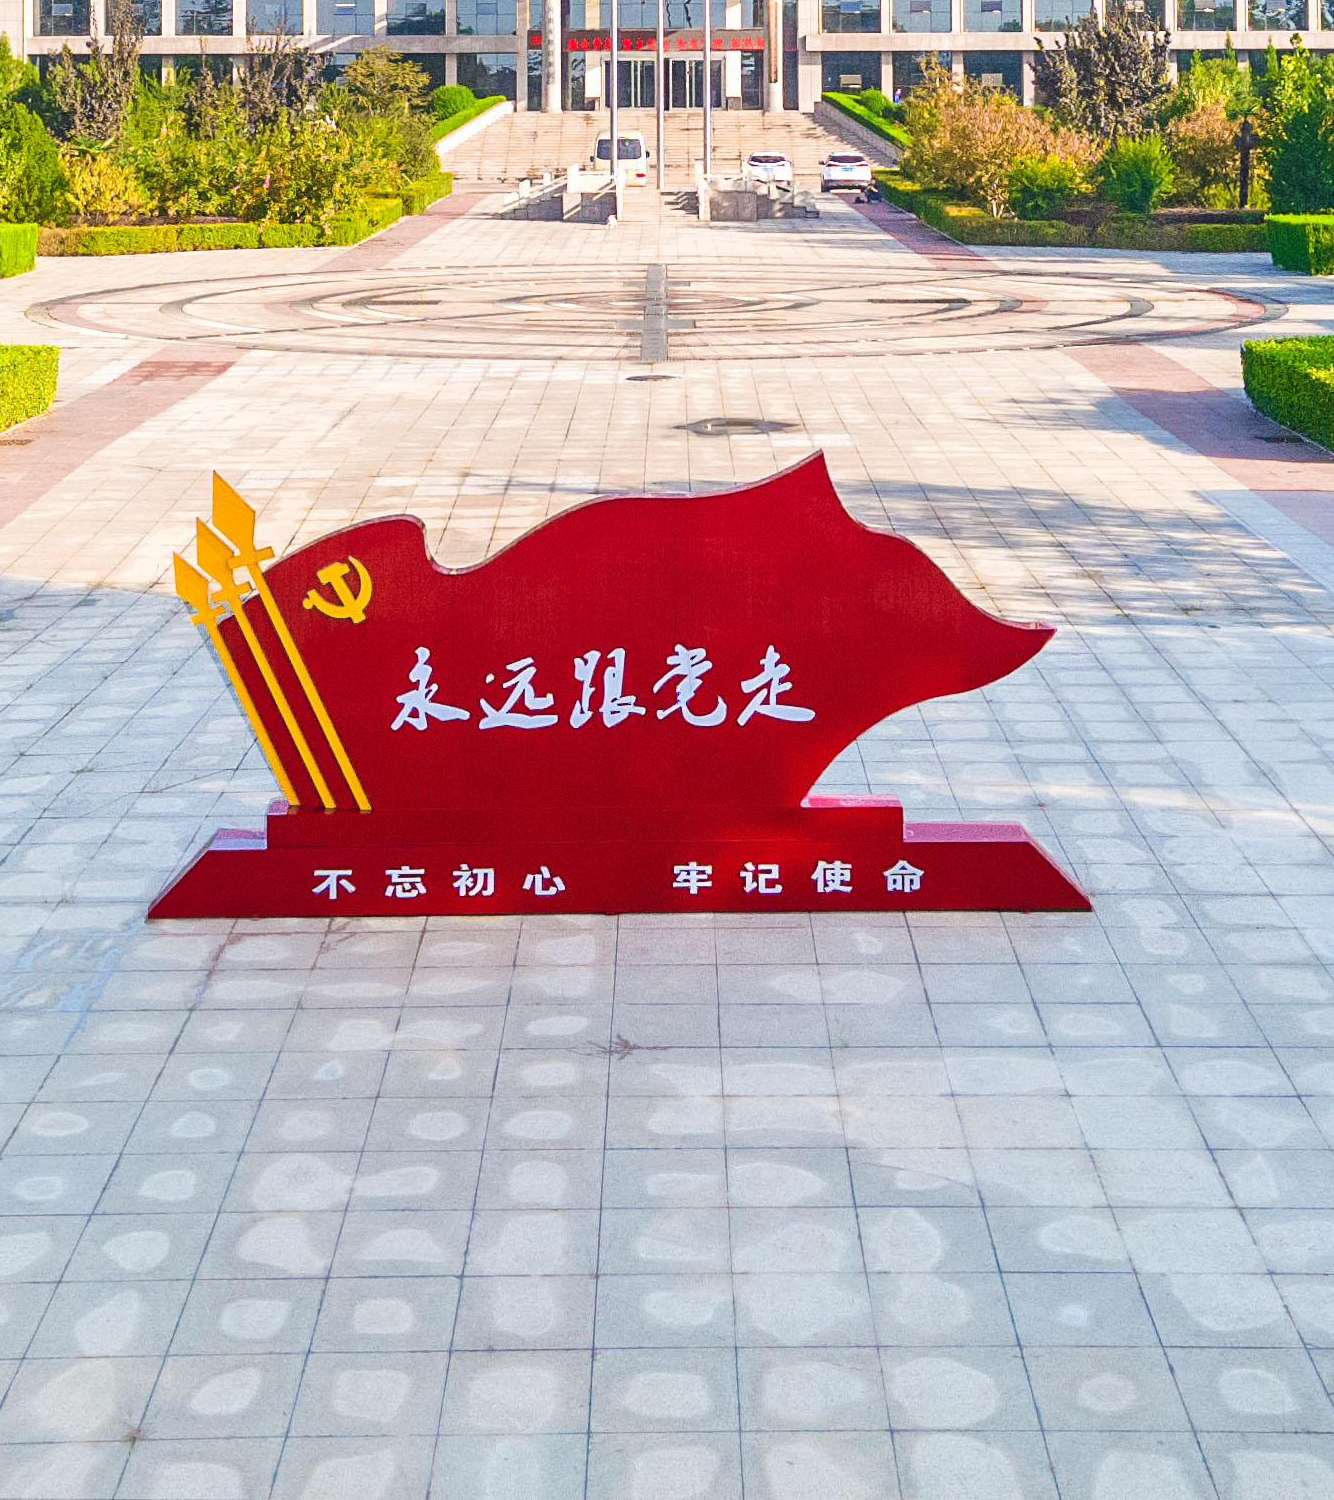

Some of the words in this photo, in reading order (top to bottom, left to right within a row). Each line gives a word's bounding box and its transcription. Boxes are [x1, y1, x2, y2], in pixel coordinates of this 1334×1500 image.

[390, 644, 816, 731] 永远跟党走
[312, 863, 566, 900] 不忘初心
[672, 860, 925, 895] 牢记使命
